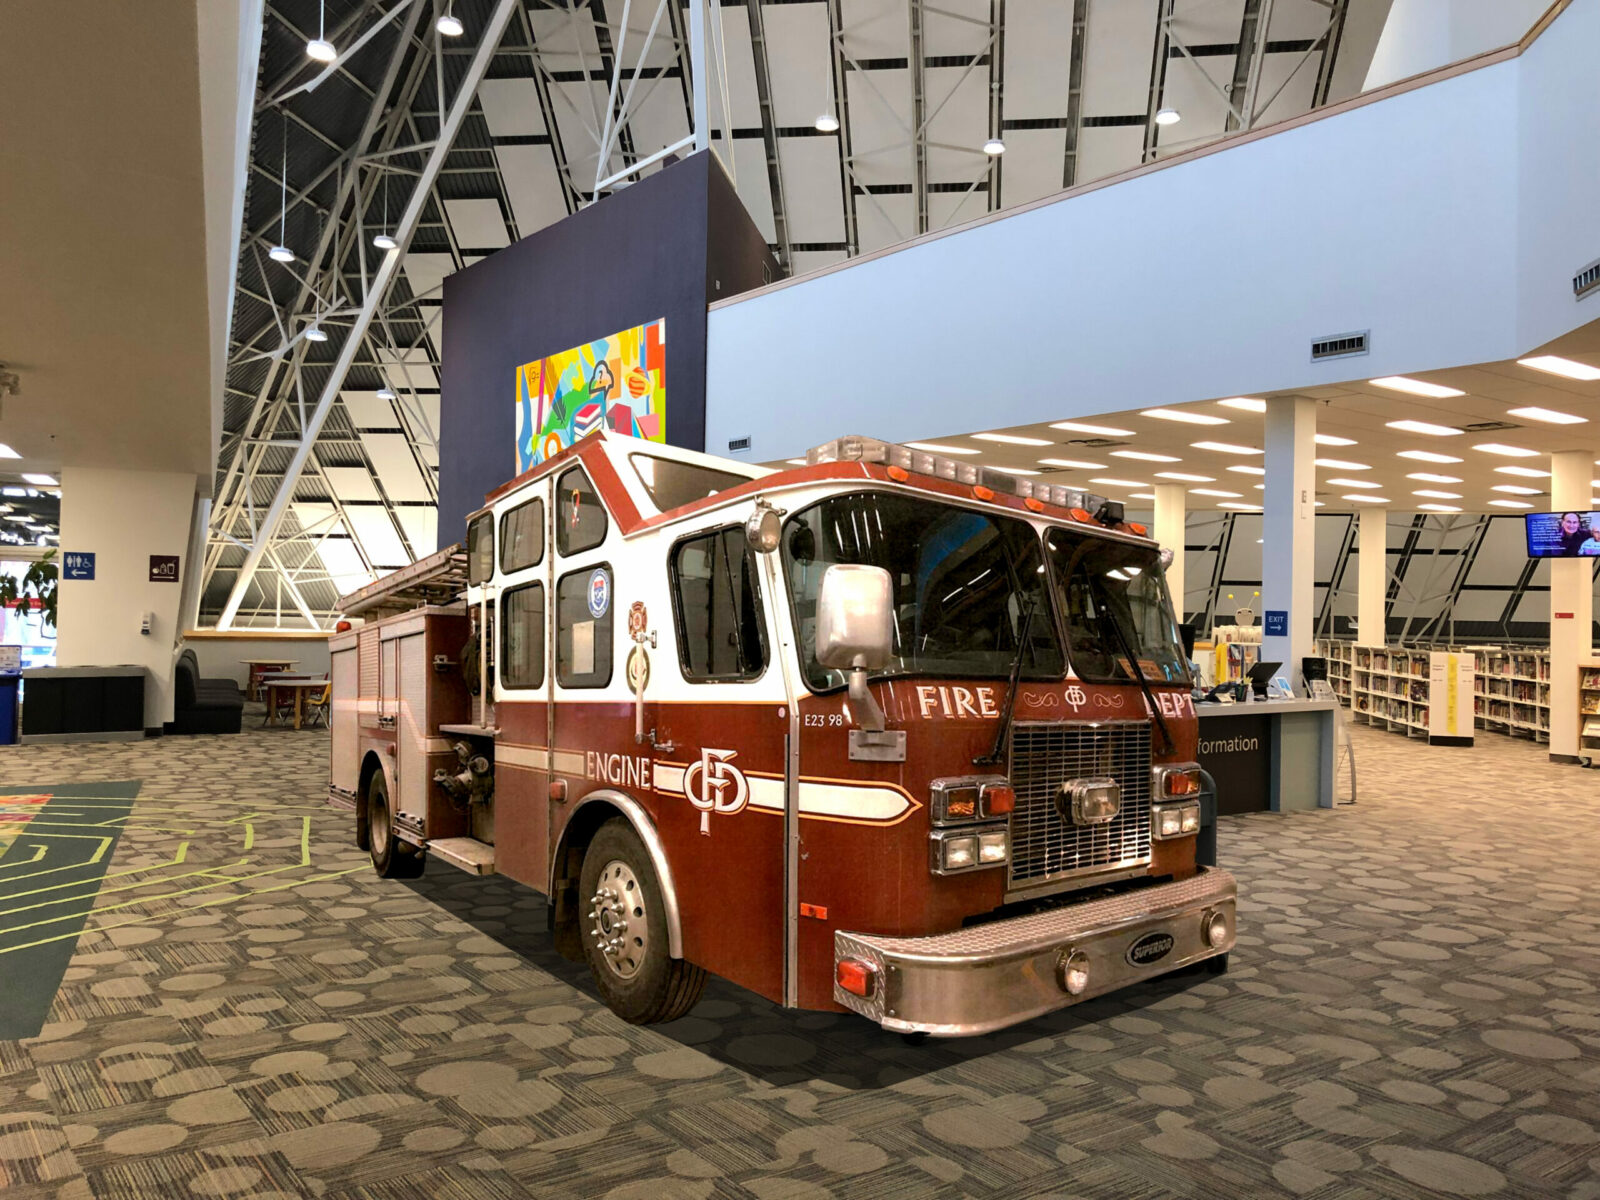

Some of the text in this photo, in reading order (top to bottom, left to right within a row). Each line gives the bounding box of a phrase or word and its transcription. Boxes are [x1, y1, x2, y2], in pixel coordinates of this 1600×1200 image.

[1268, 615, 1285, 623] EXIT
[916, 686, 1000, 719] FIRE
[804, 713, 843, 727] E23 98
[1197, 735, 1259, 755] formation
[586, 751, 651, 791] ENGINE
